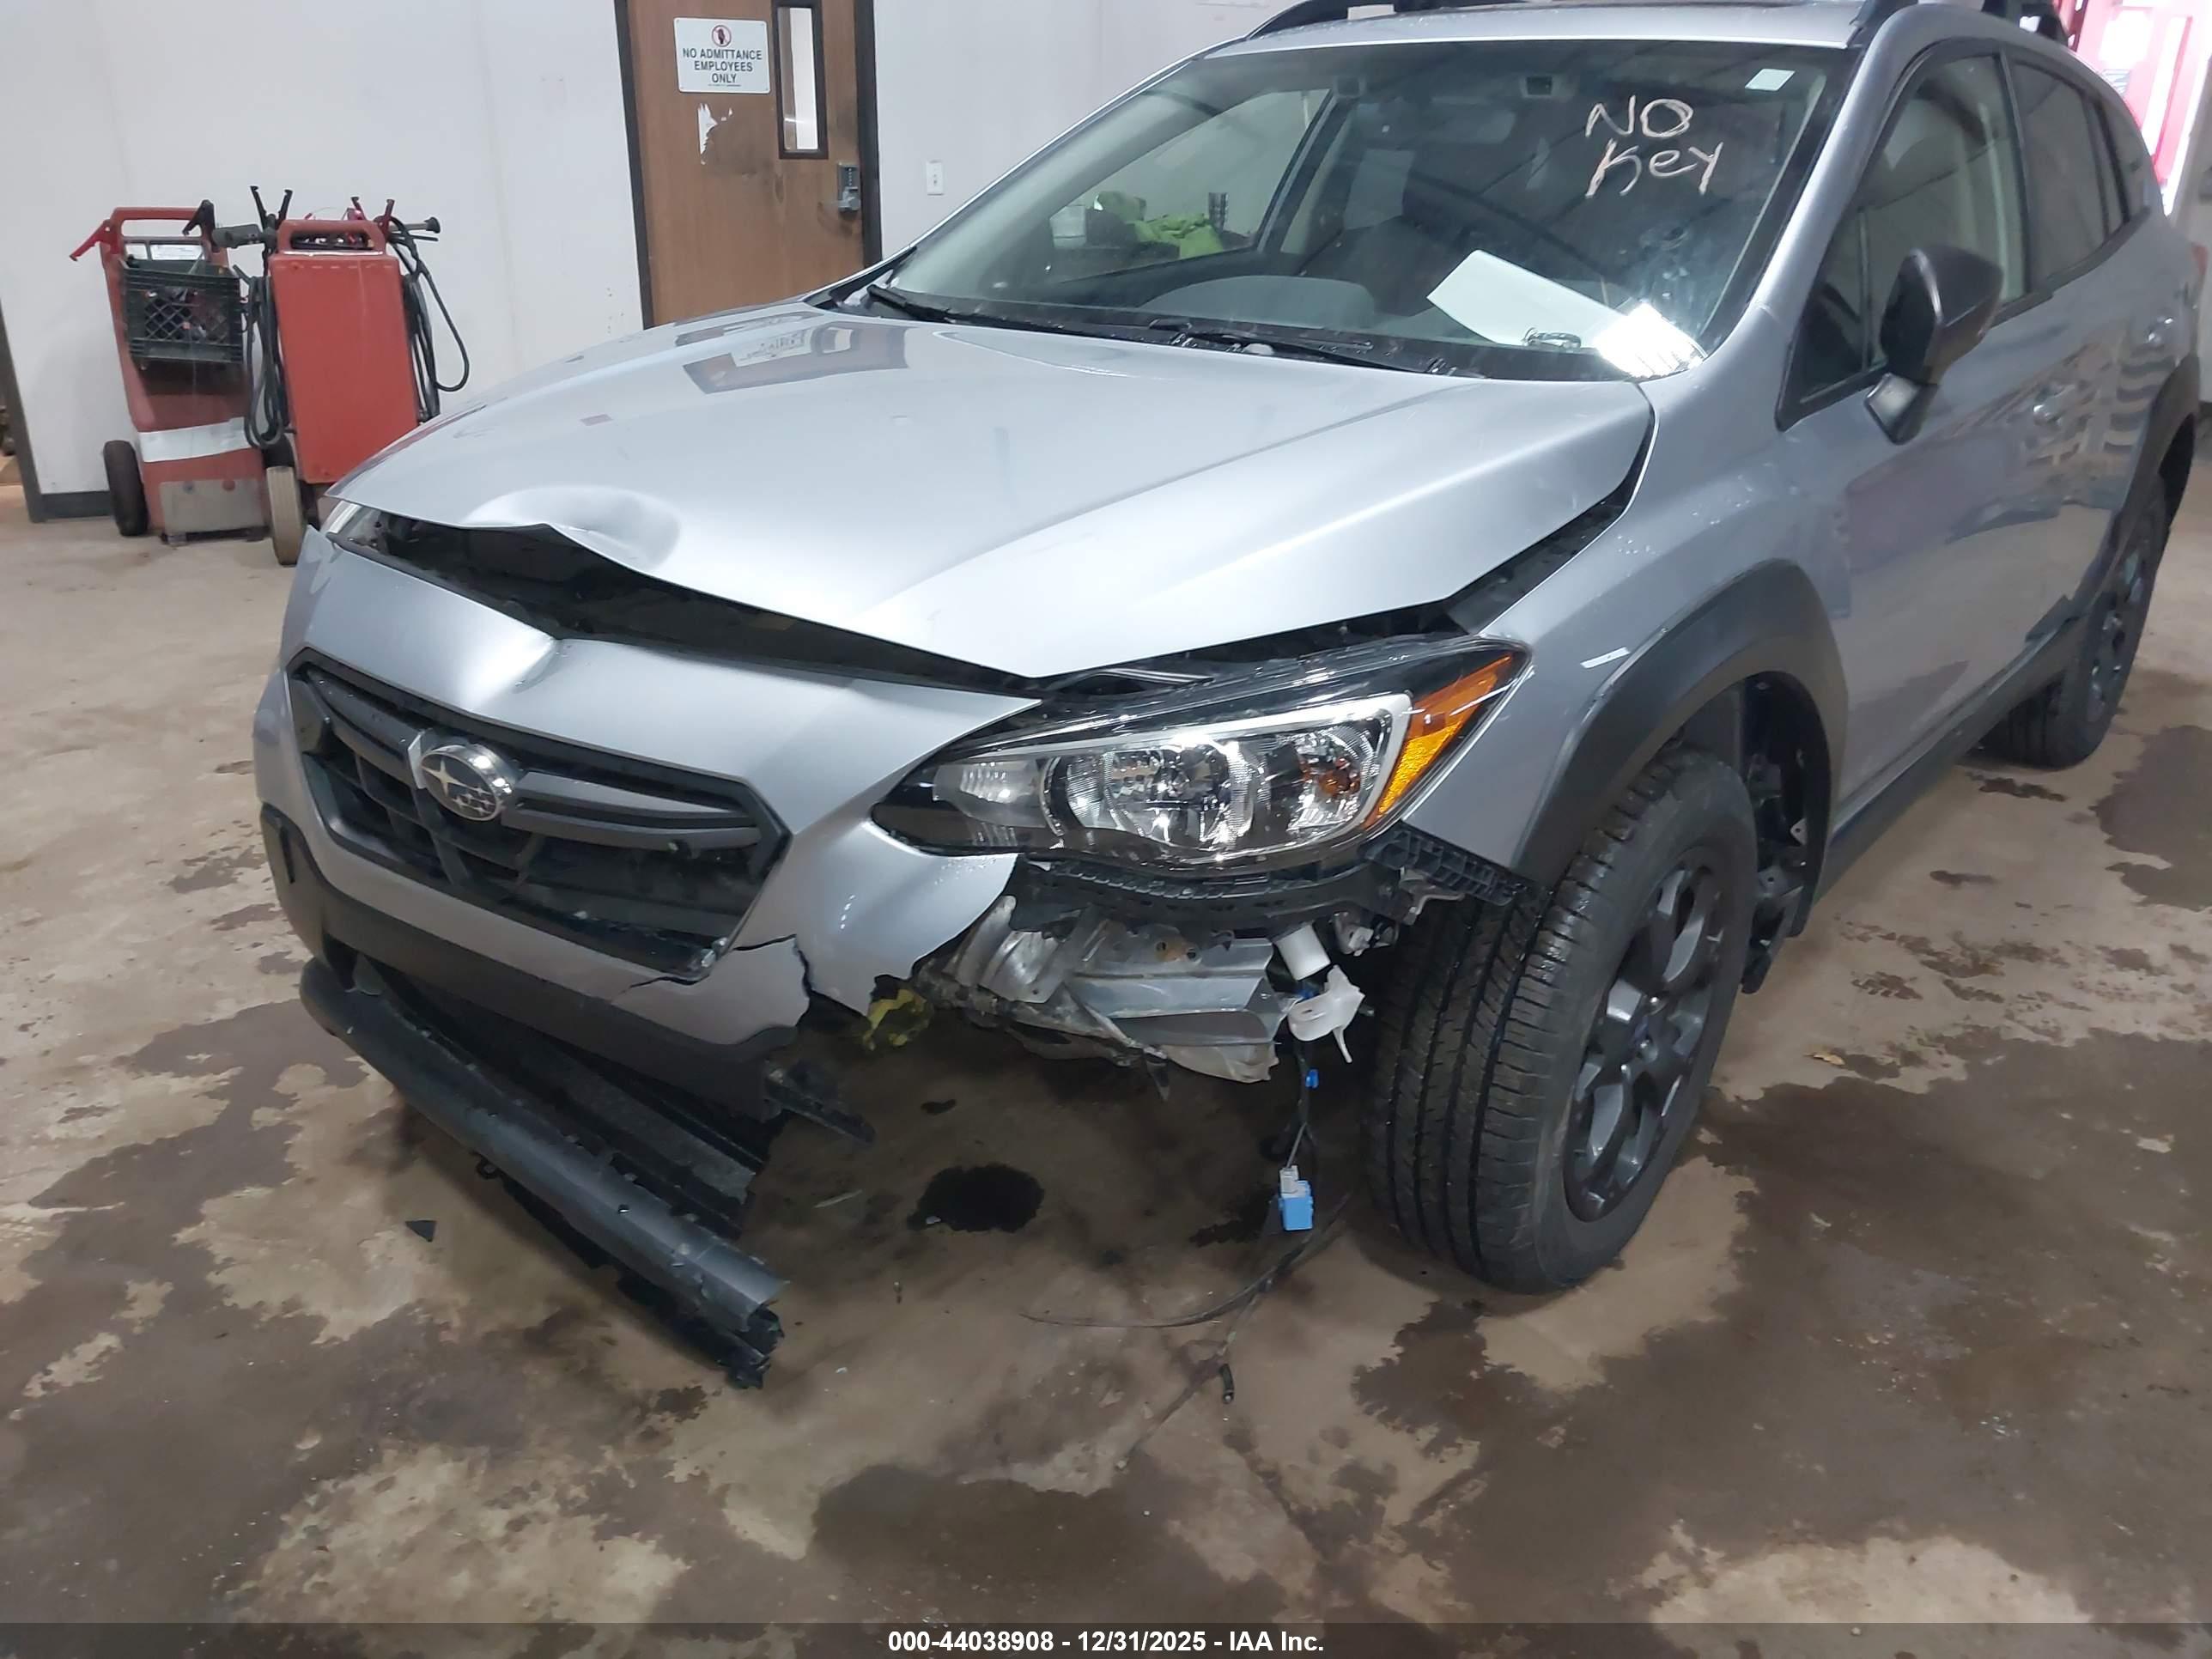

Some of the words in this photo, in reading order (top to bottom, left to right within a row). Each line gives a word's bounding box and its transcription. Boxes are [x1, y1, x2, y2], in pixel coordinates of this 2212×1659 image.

[683, 48, 696, 58] NO
[700, 49, 763, 60] ADMITTANCE
[694, 61, 753, 71] EMPLOYEES
[711, 73, 737, 83] ONLY
[1585, 95, 1693, 138] NO
